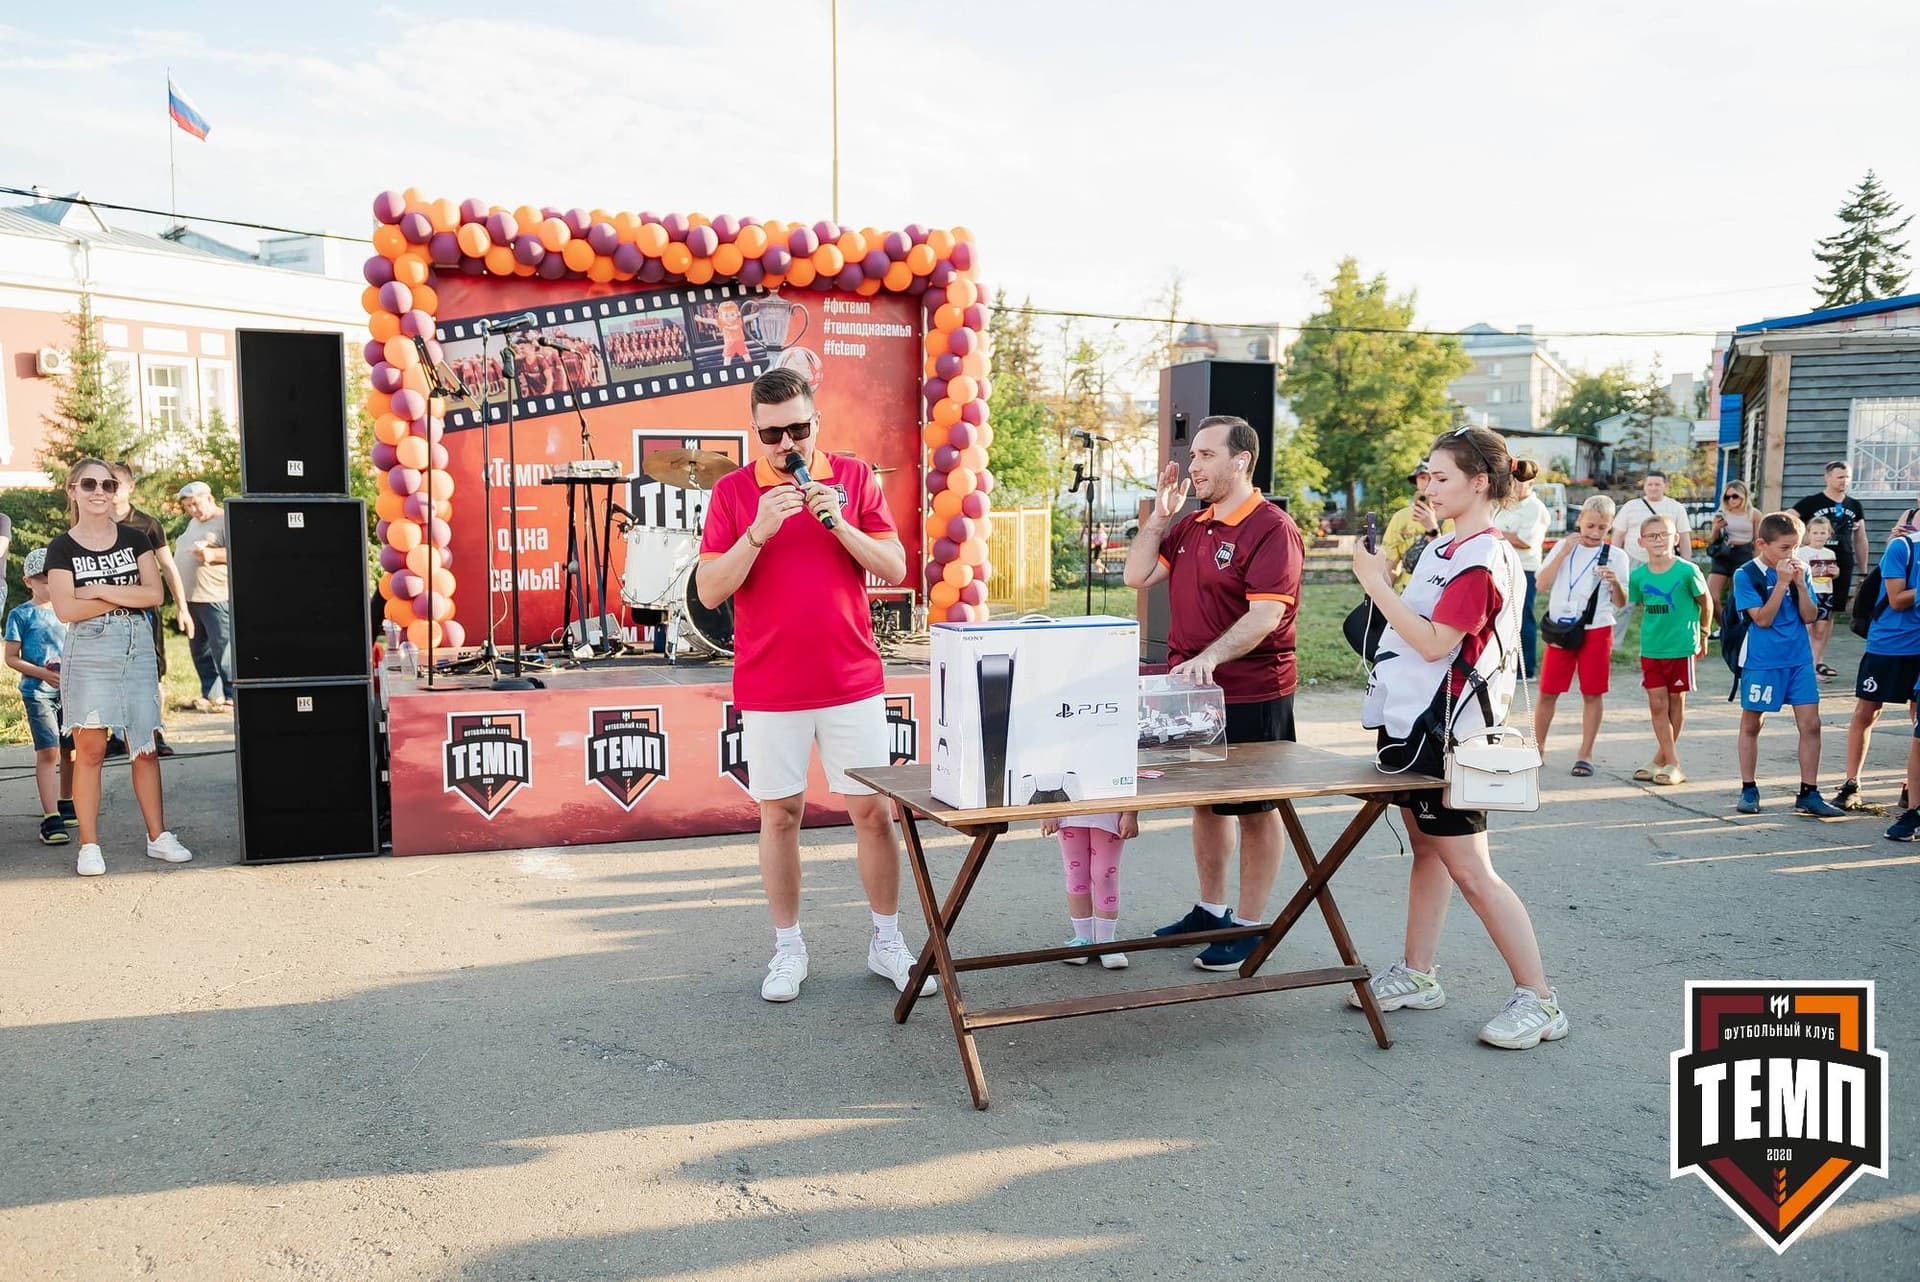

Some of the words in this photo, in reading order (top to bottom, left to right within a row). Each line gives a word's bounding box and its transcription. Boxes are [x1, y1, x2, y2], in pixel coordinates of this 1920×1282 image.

[823, 298, 871, 316] #фктемп
[823, 318, 912, 338] #темподнасемья
[823, 339, 866, 359] #fctemp
[481, 457, 554, 487] «Темп
[72, 555, 97, 573] BIG
[97, 546, 136, 571] EVENT
[1748, 683, 1773, 705] 54
[1078, 702, 1119, 715] PS5
[452, 741, 524, 780] ТЕМП
[593, 735, 661, 773] ТЕМП
